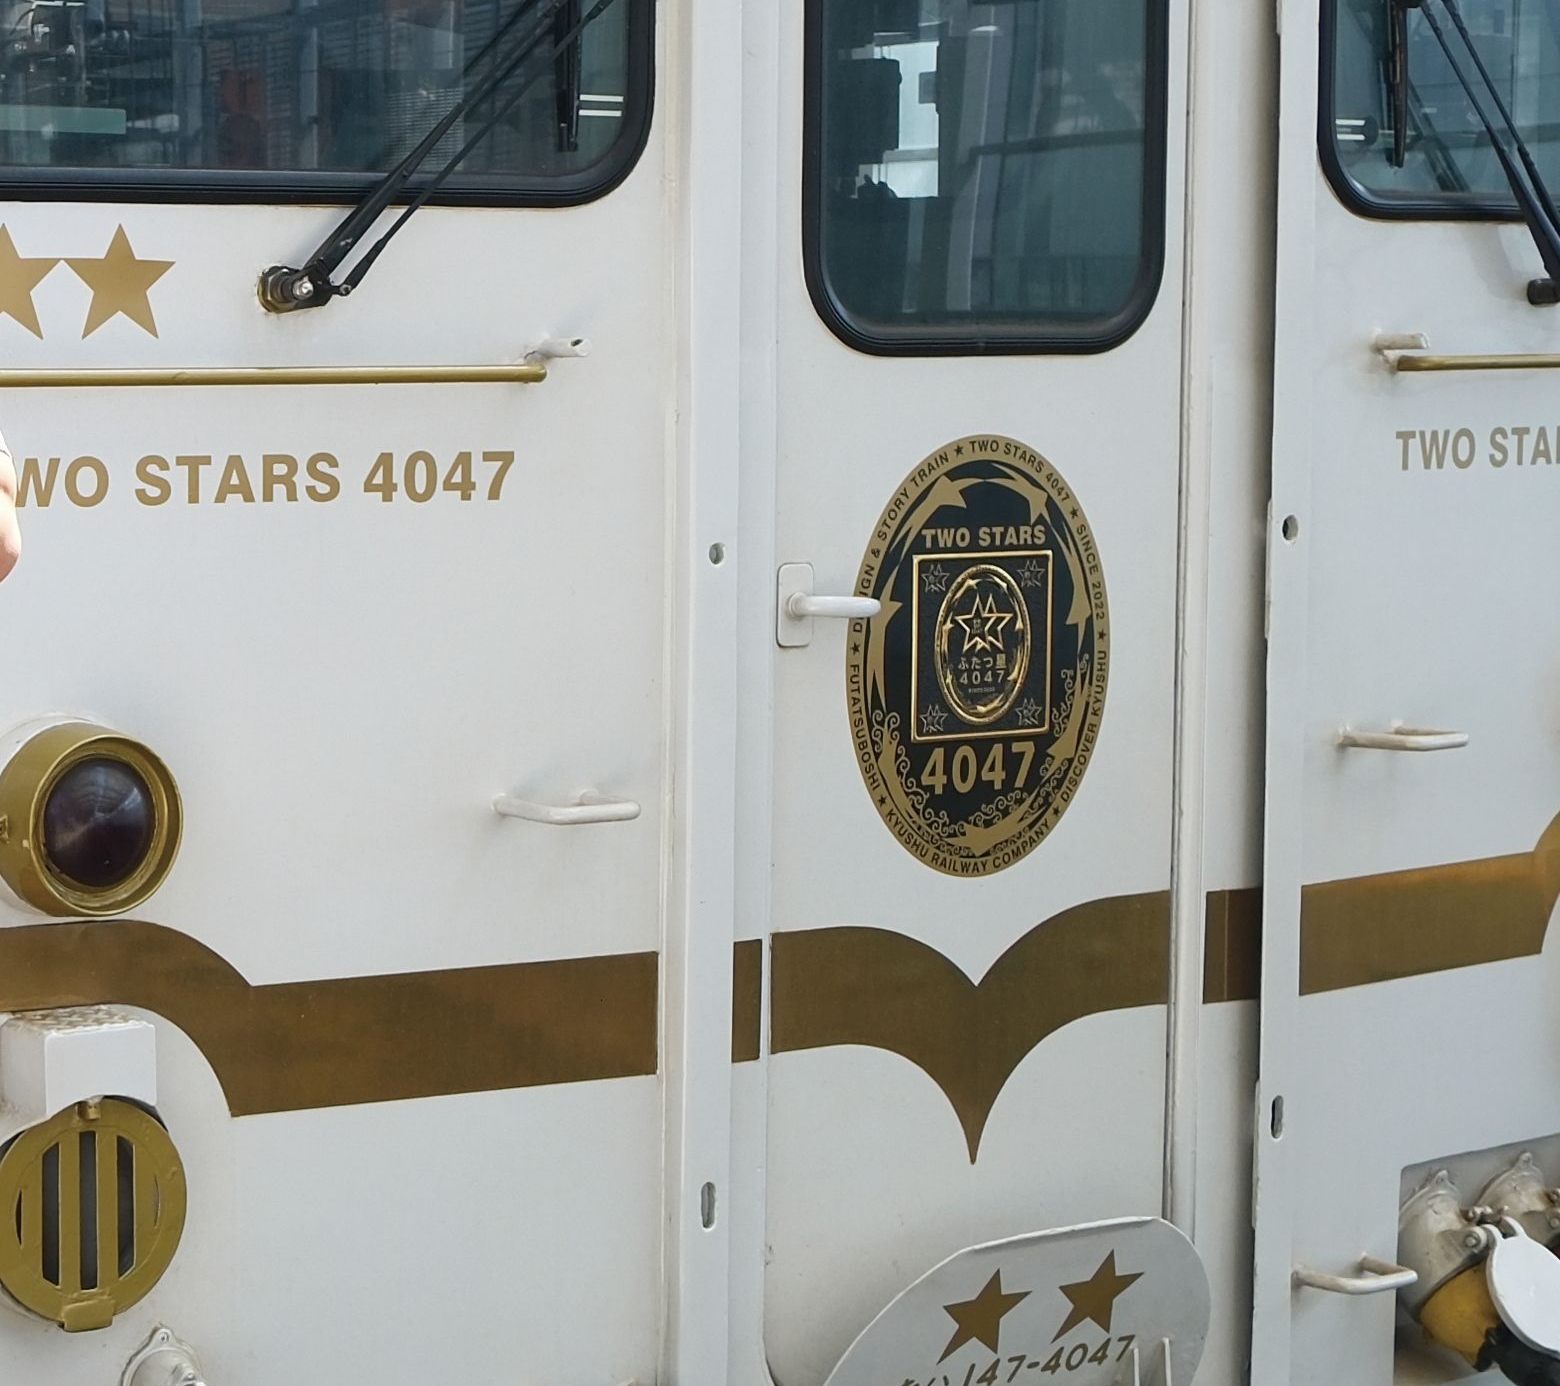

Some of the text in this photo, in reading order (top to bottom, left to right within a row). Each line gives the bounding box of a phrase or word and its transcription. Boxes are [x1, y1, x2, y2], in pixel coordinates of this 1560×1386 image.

[15, 450, 515, 507] WO STARS 4047
[969, 439, 1069, 503] TWO STARS 4047
[1396, 428, 1476, 471] TWO
[871, 548, 880, 558] &
[877, 488, 910, 541] STORY
[910, 451, 949, 488] TRAIN
[921, 524, 1046, 549] TWO STARS
[1076, 523, 1105, 621] SINCE 2022
[960, 670, 1004, 685] 4047
[849, 664, 880, 792] FUTATSUBOSHI
[1062, 649, 1107, 803] DISCOVER KYUSHU
[920, 741, 1036, 795] 4047
[886, 809, 1050, 875] KYUSHU RAILWAY COMPANY
